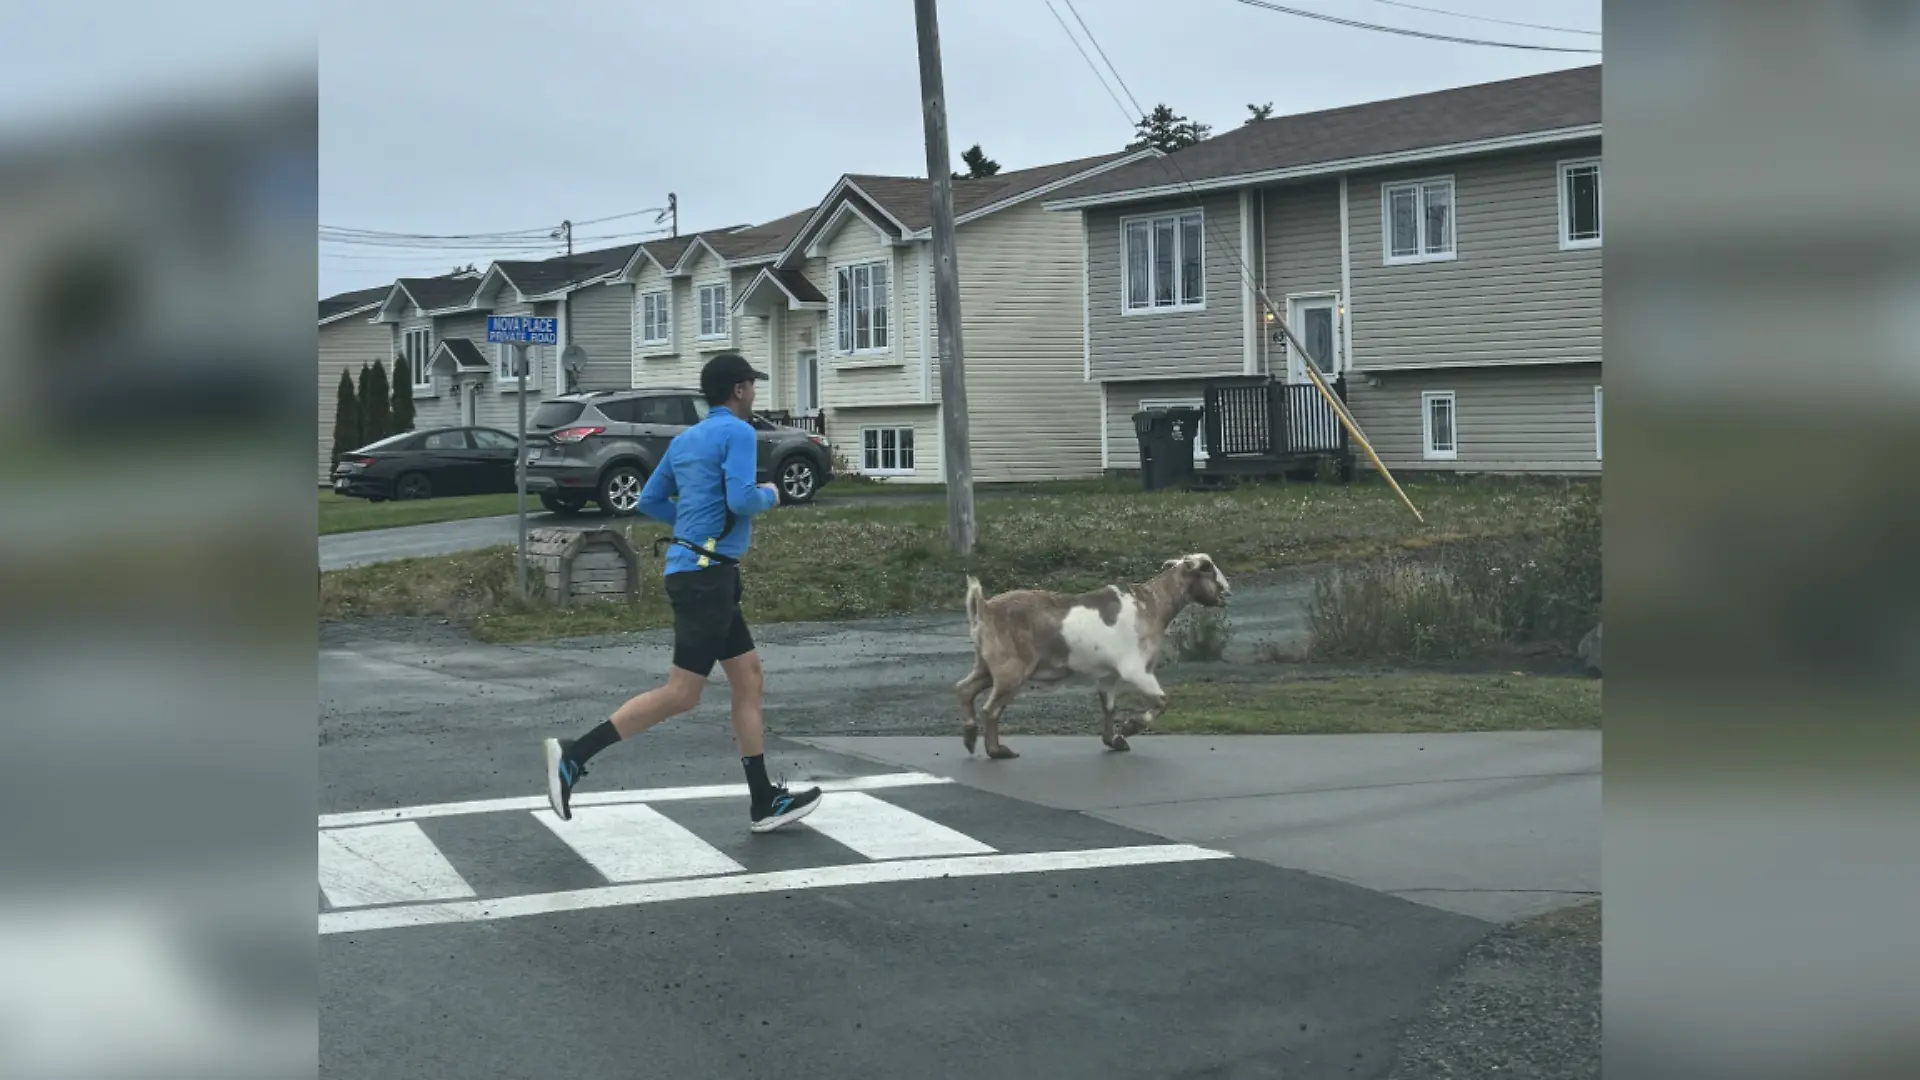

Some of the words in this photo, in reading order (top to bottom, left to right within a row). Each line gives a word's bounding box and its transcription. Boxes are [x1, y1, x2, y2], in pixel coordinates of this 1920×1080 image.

[493, 317, 519, 331] NOVA
[523, 318, 553, 333] PLACE
[489, 331, 527, 342] PRIVATE
[531, 333, 556, 344] ROAD
